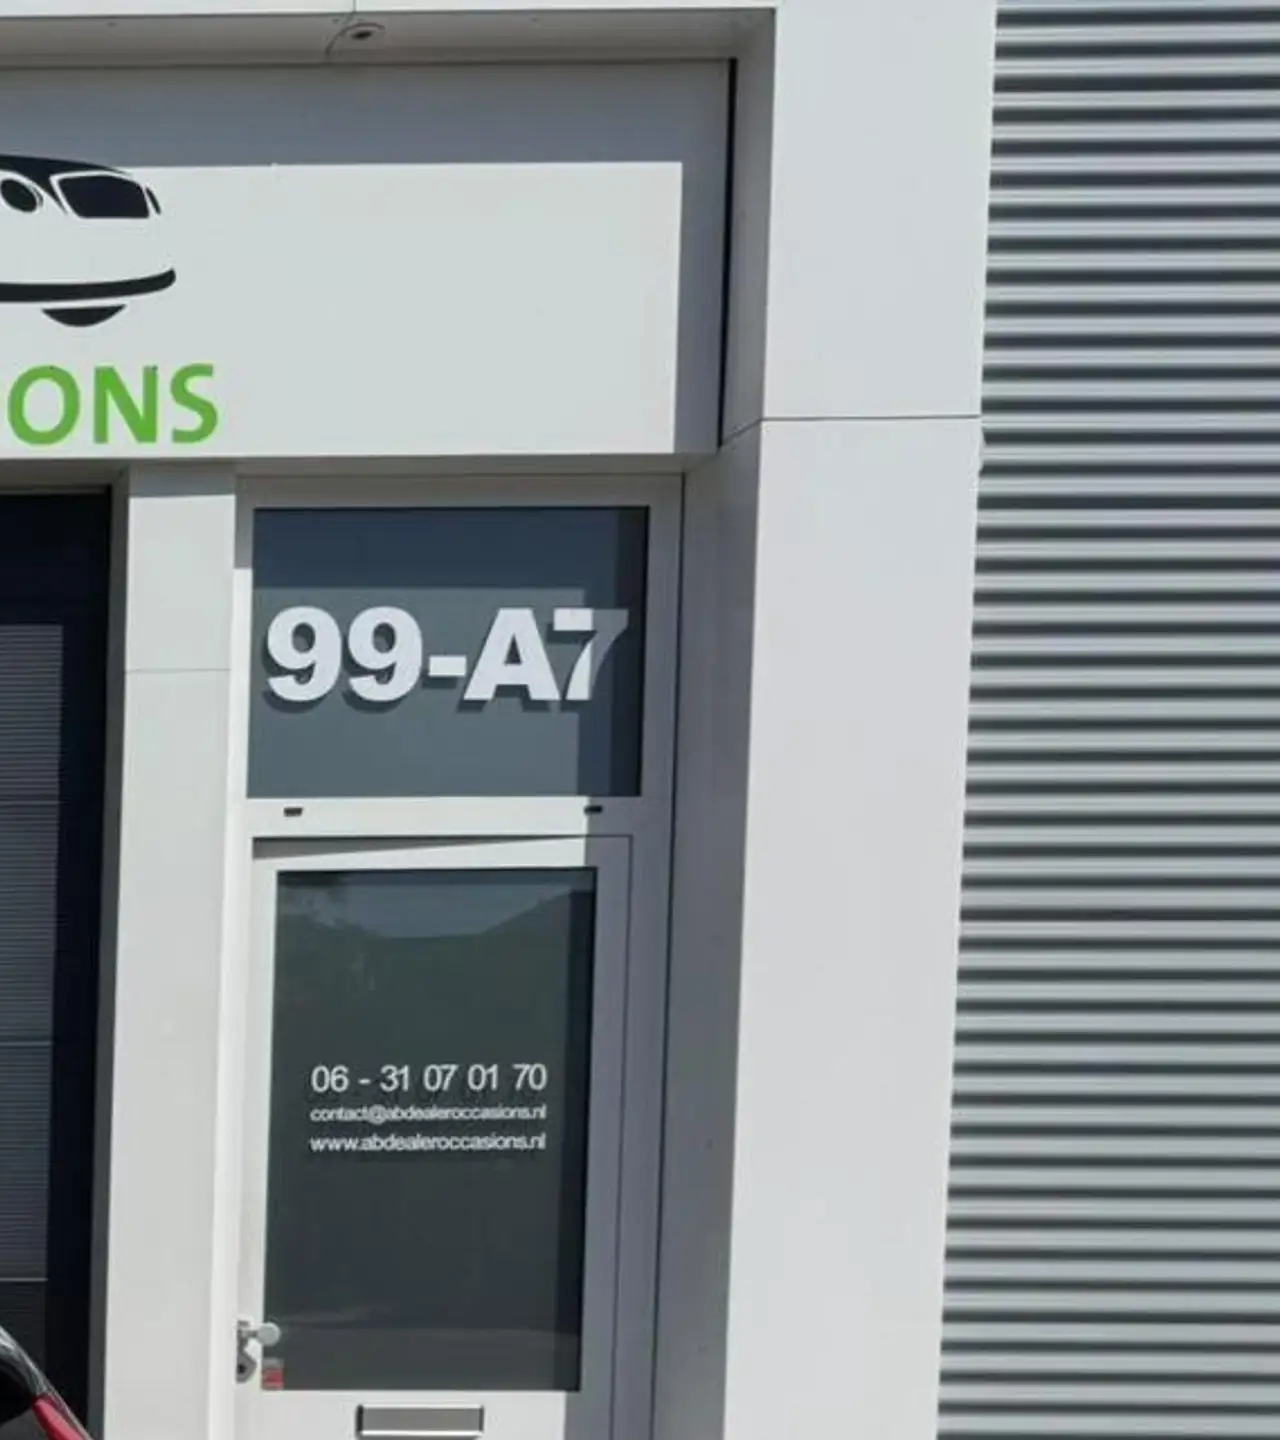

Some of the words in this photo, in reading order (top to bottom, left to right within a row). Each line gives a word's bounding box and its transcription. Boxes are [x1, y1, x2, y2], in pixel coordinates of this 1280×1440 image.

[267, 606, 629, 702] 99-A7
[311, 1065, 349, 1092] 06
[379, 1065, 410, 1092] 31
[423, 1064, 458, 1091] 07
[467, 1064, 498, 1091] 01
[513, 1063, 547, 1091] 70
[310, 1104, 547, 1124] contact@abdealeroccasions.nl
[310, 1133, 547, 1151] www.abdealeroccasions.nl
